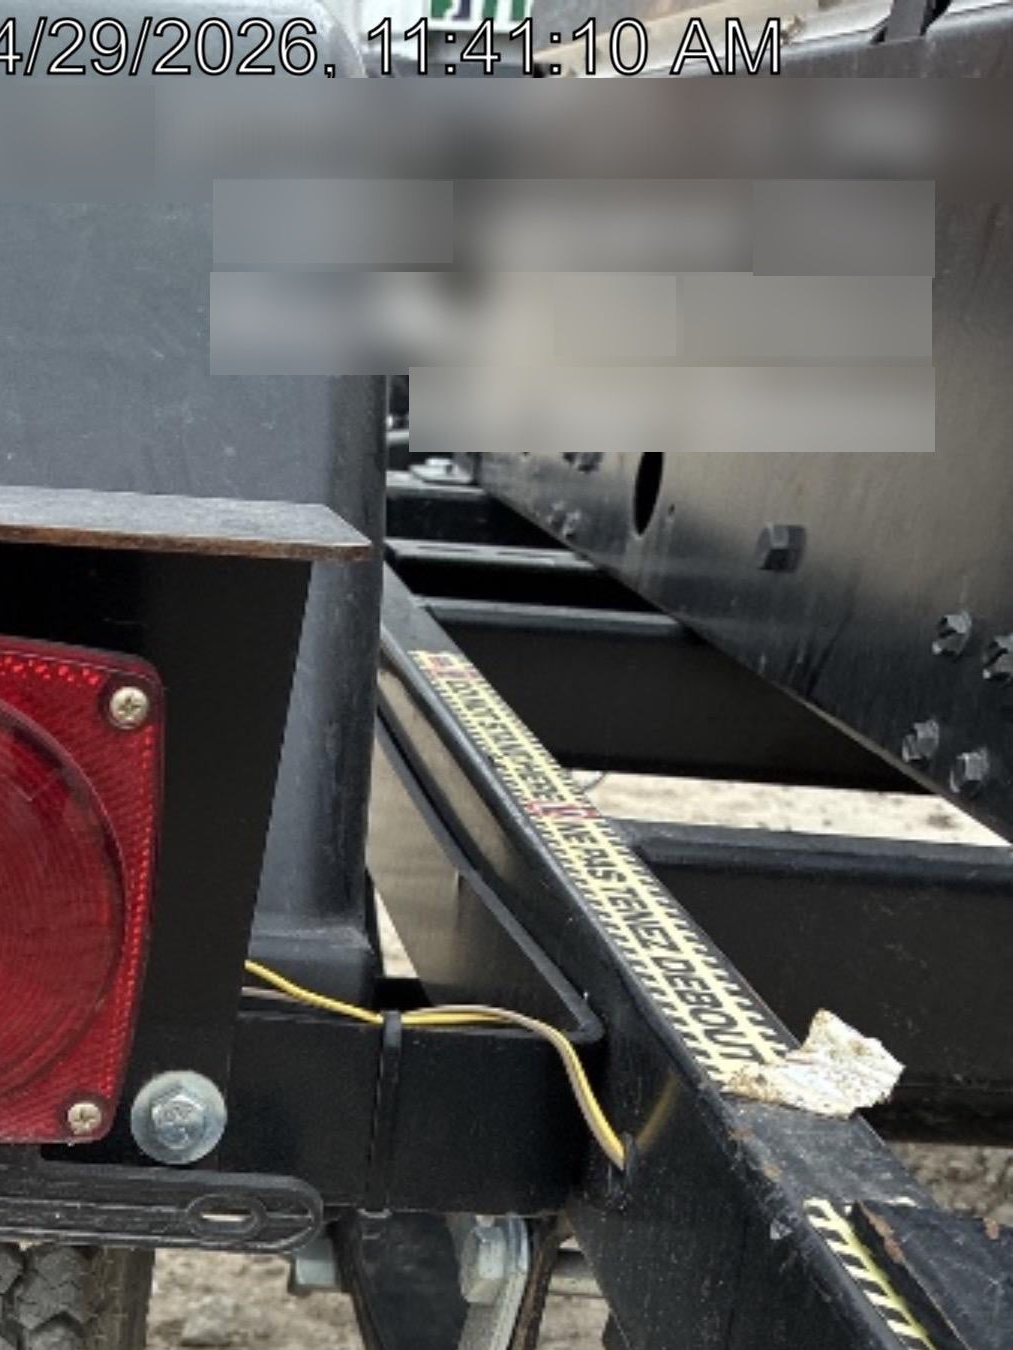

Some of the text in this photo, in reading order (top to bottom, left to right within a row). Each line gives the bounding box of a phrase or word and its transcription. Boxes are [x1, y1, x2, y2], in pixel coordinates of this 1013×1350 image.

[576, 847, 626, 882] PAS
[600, 886, 681, 954] TENEZ
[650, 956, 766, 1065] DEBOUT
